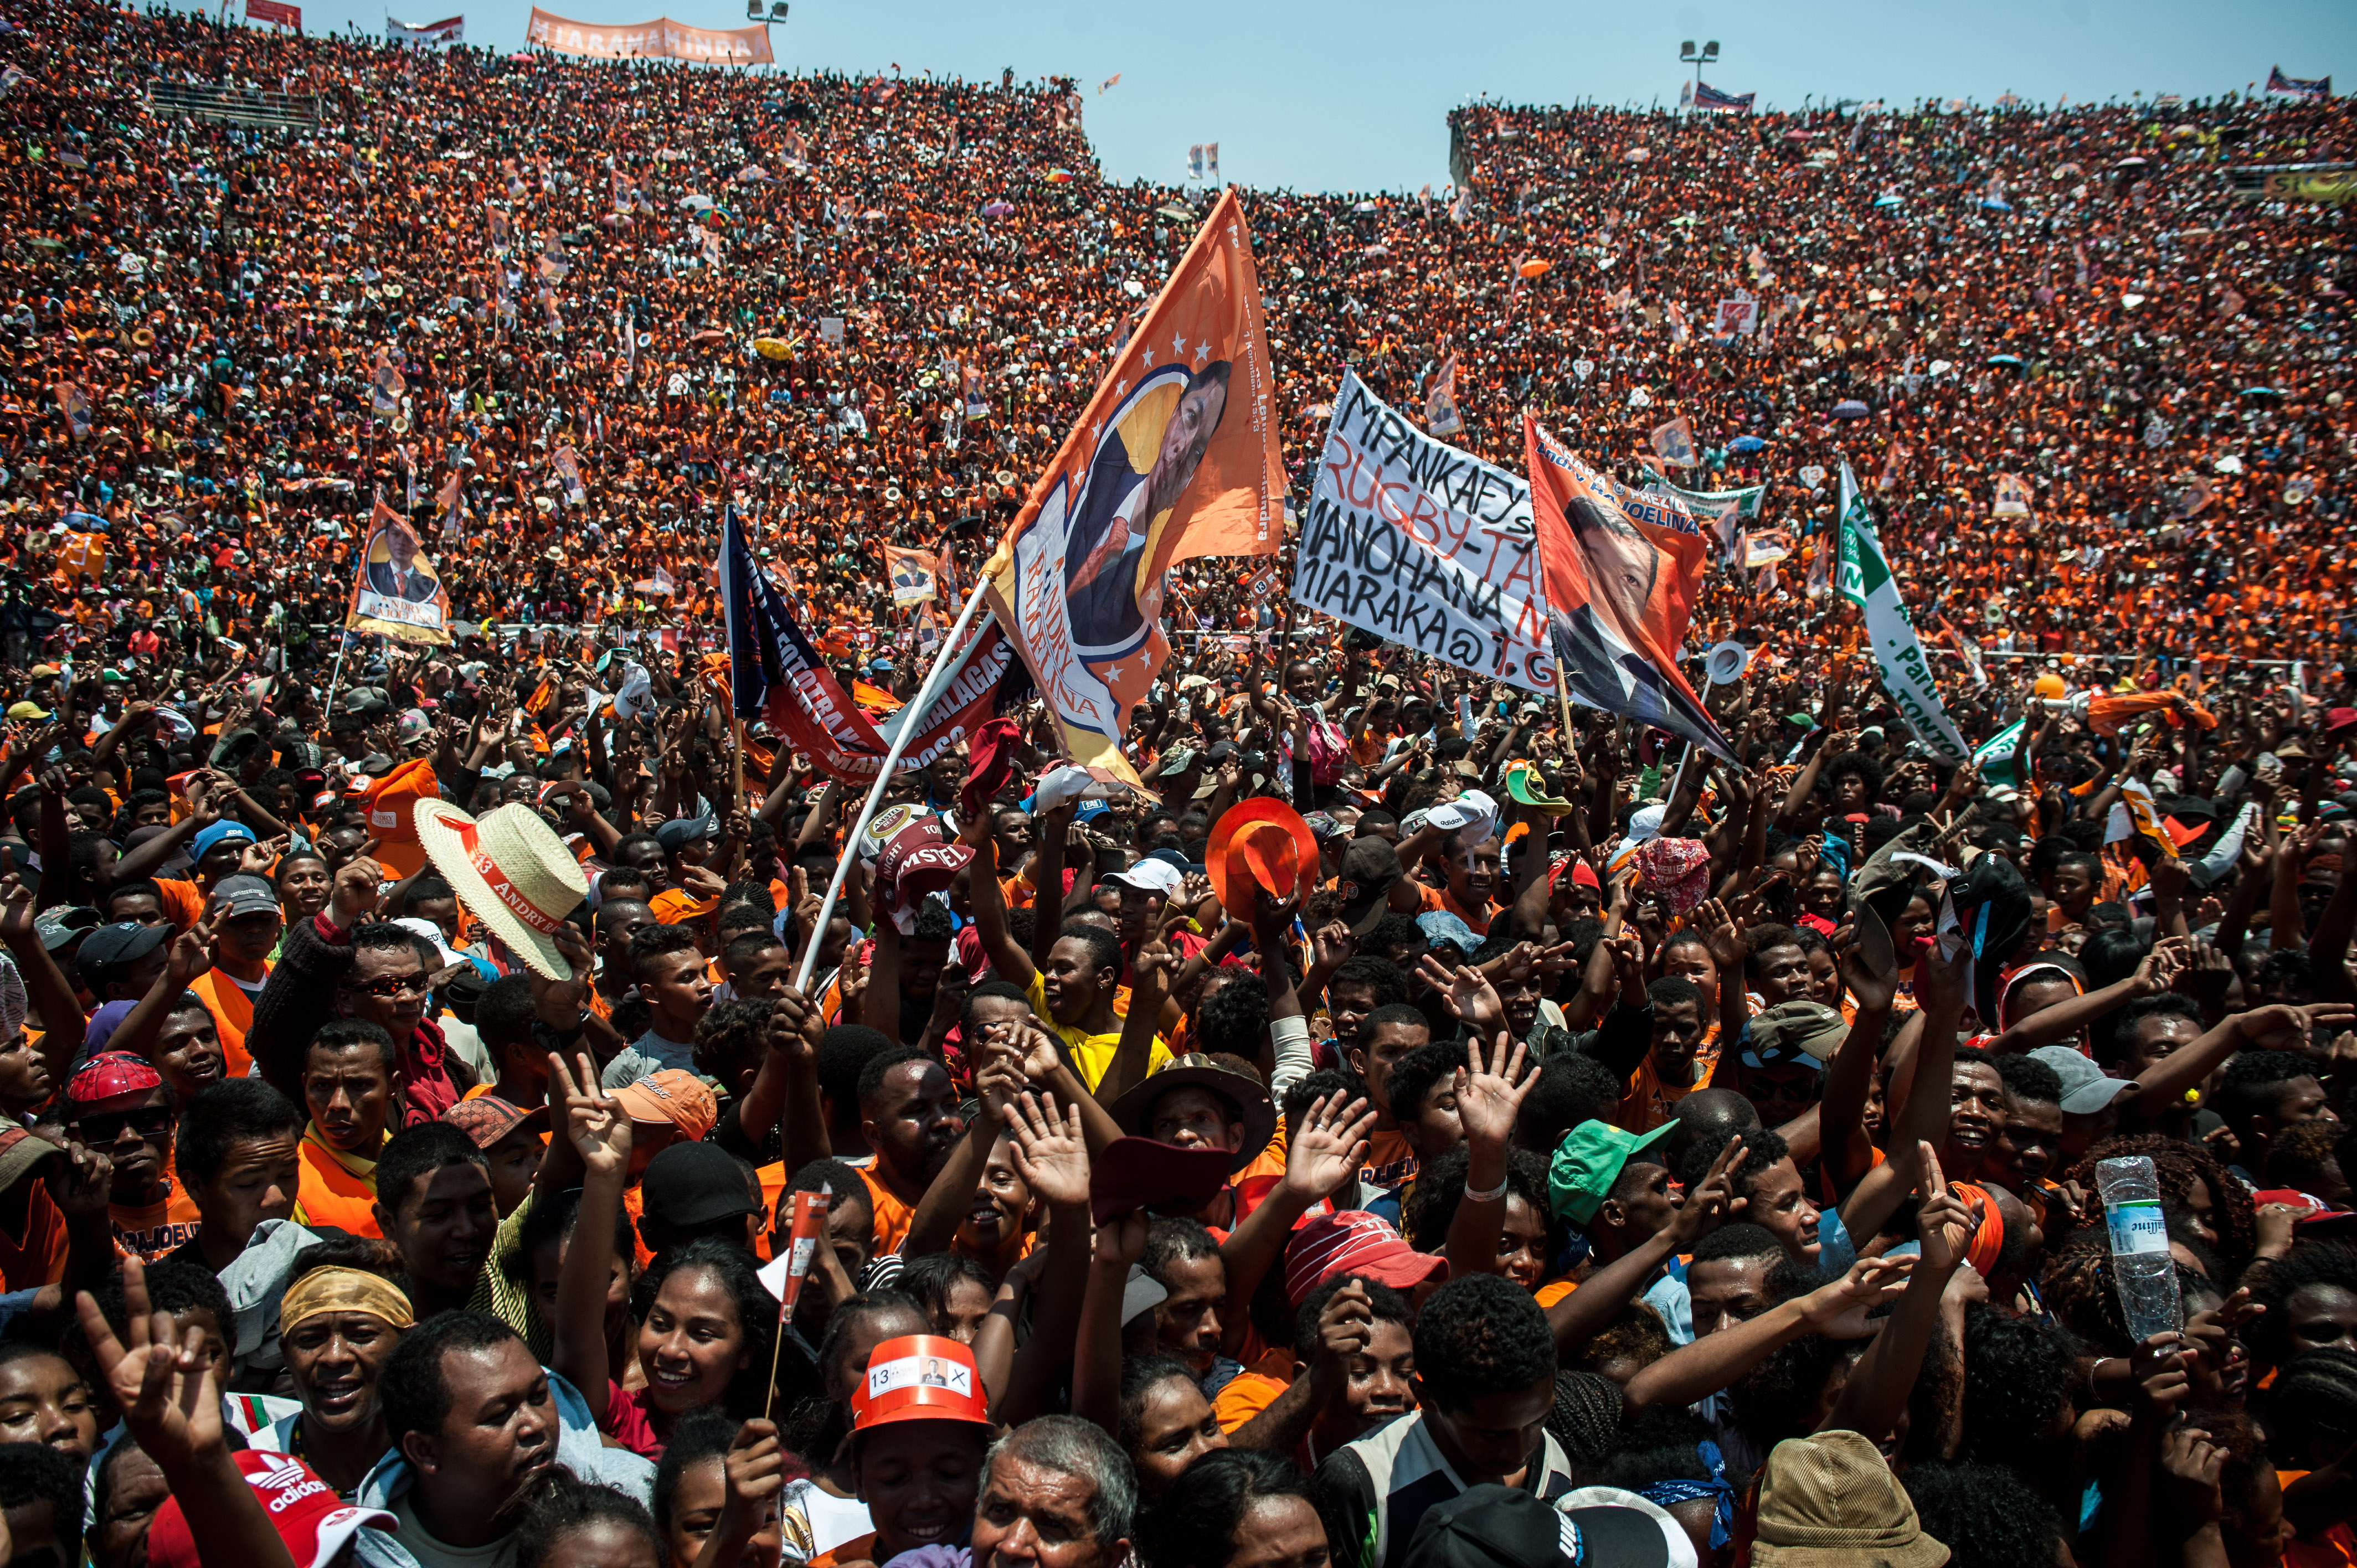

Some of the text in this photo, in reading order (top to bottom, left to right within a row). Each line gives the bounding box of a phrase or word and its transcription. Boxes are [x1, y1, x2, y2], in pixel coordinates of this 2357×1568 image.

[1574, 363, 1590, 373] 13
[1802, 467, 1820, 481] 13
[1630, 487, 1692, 518] PREZID
[1326, 434, 1545, 596] RUGBY-TA
[1255, 581, 1266, 592] 13
[914, 638, 1014, 739] MALAGAS
[874, 807, 901, 829] AMSTEL
[882, 814, 898, 828] BEER
[1440, 817, 1463, 826] adidas
[477, 854, 493, 874] 13
[897, 845, 968, 881] MSTEL
[1657, 863, 1686, 874] PREMIER
[493, 881, 545, 927] ANDRY
[871, 1369, 889, 1388] 13
[270, 1481, 327, 1512] adidas
